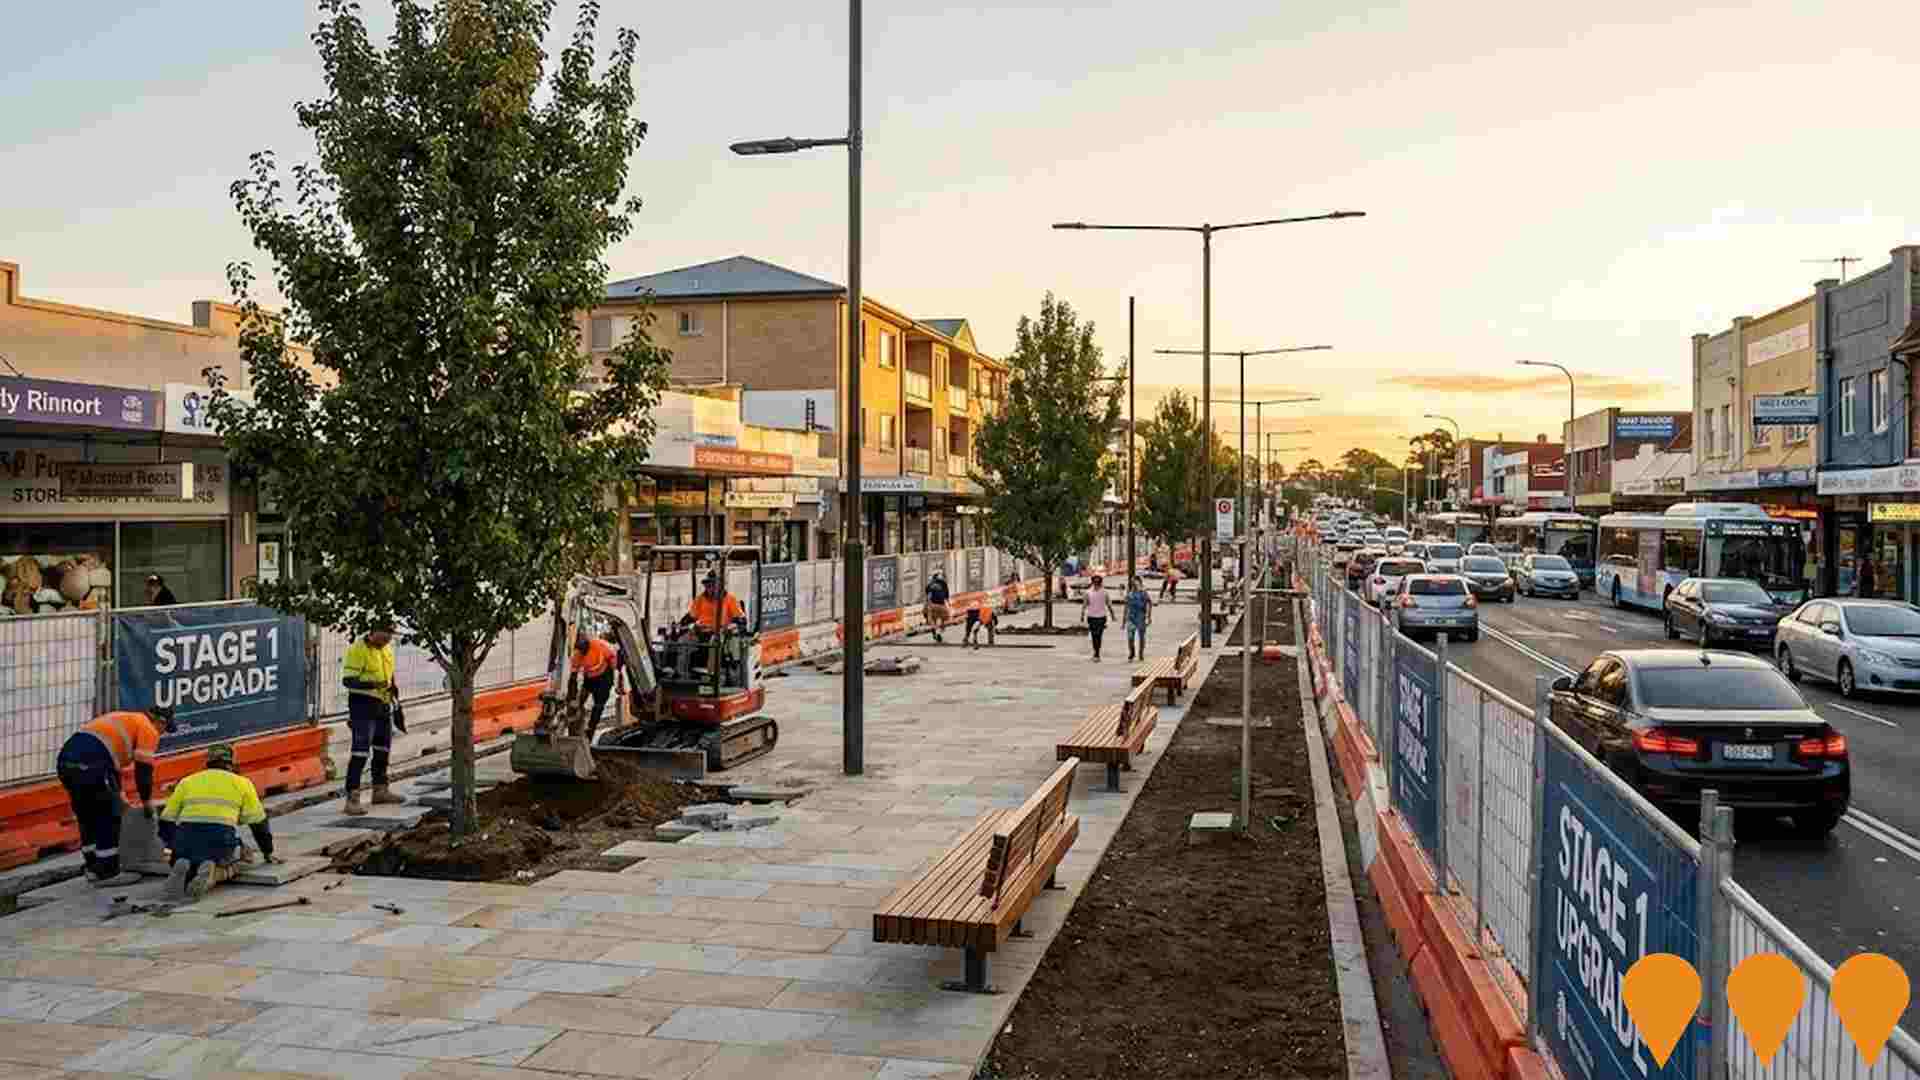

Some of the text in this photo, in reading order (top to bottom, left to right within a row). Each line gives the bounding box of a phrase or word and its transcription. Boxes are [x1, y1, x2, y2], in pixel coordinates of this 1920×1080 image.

[27, 389, 103, 416] Rinnort
[155, 627, 279, 674] STAGE 1
[154, 665, 279, 709] UPGRADE
[1559, 805, 1649, 957] STAGE 1
